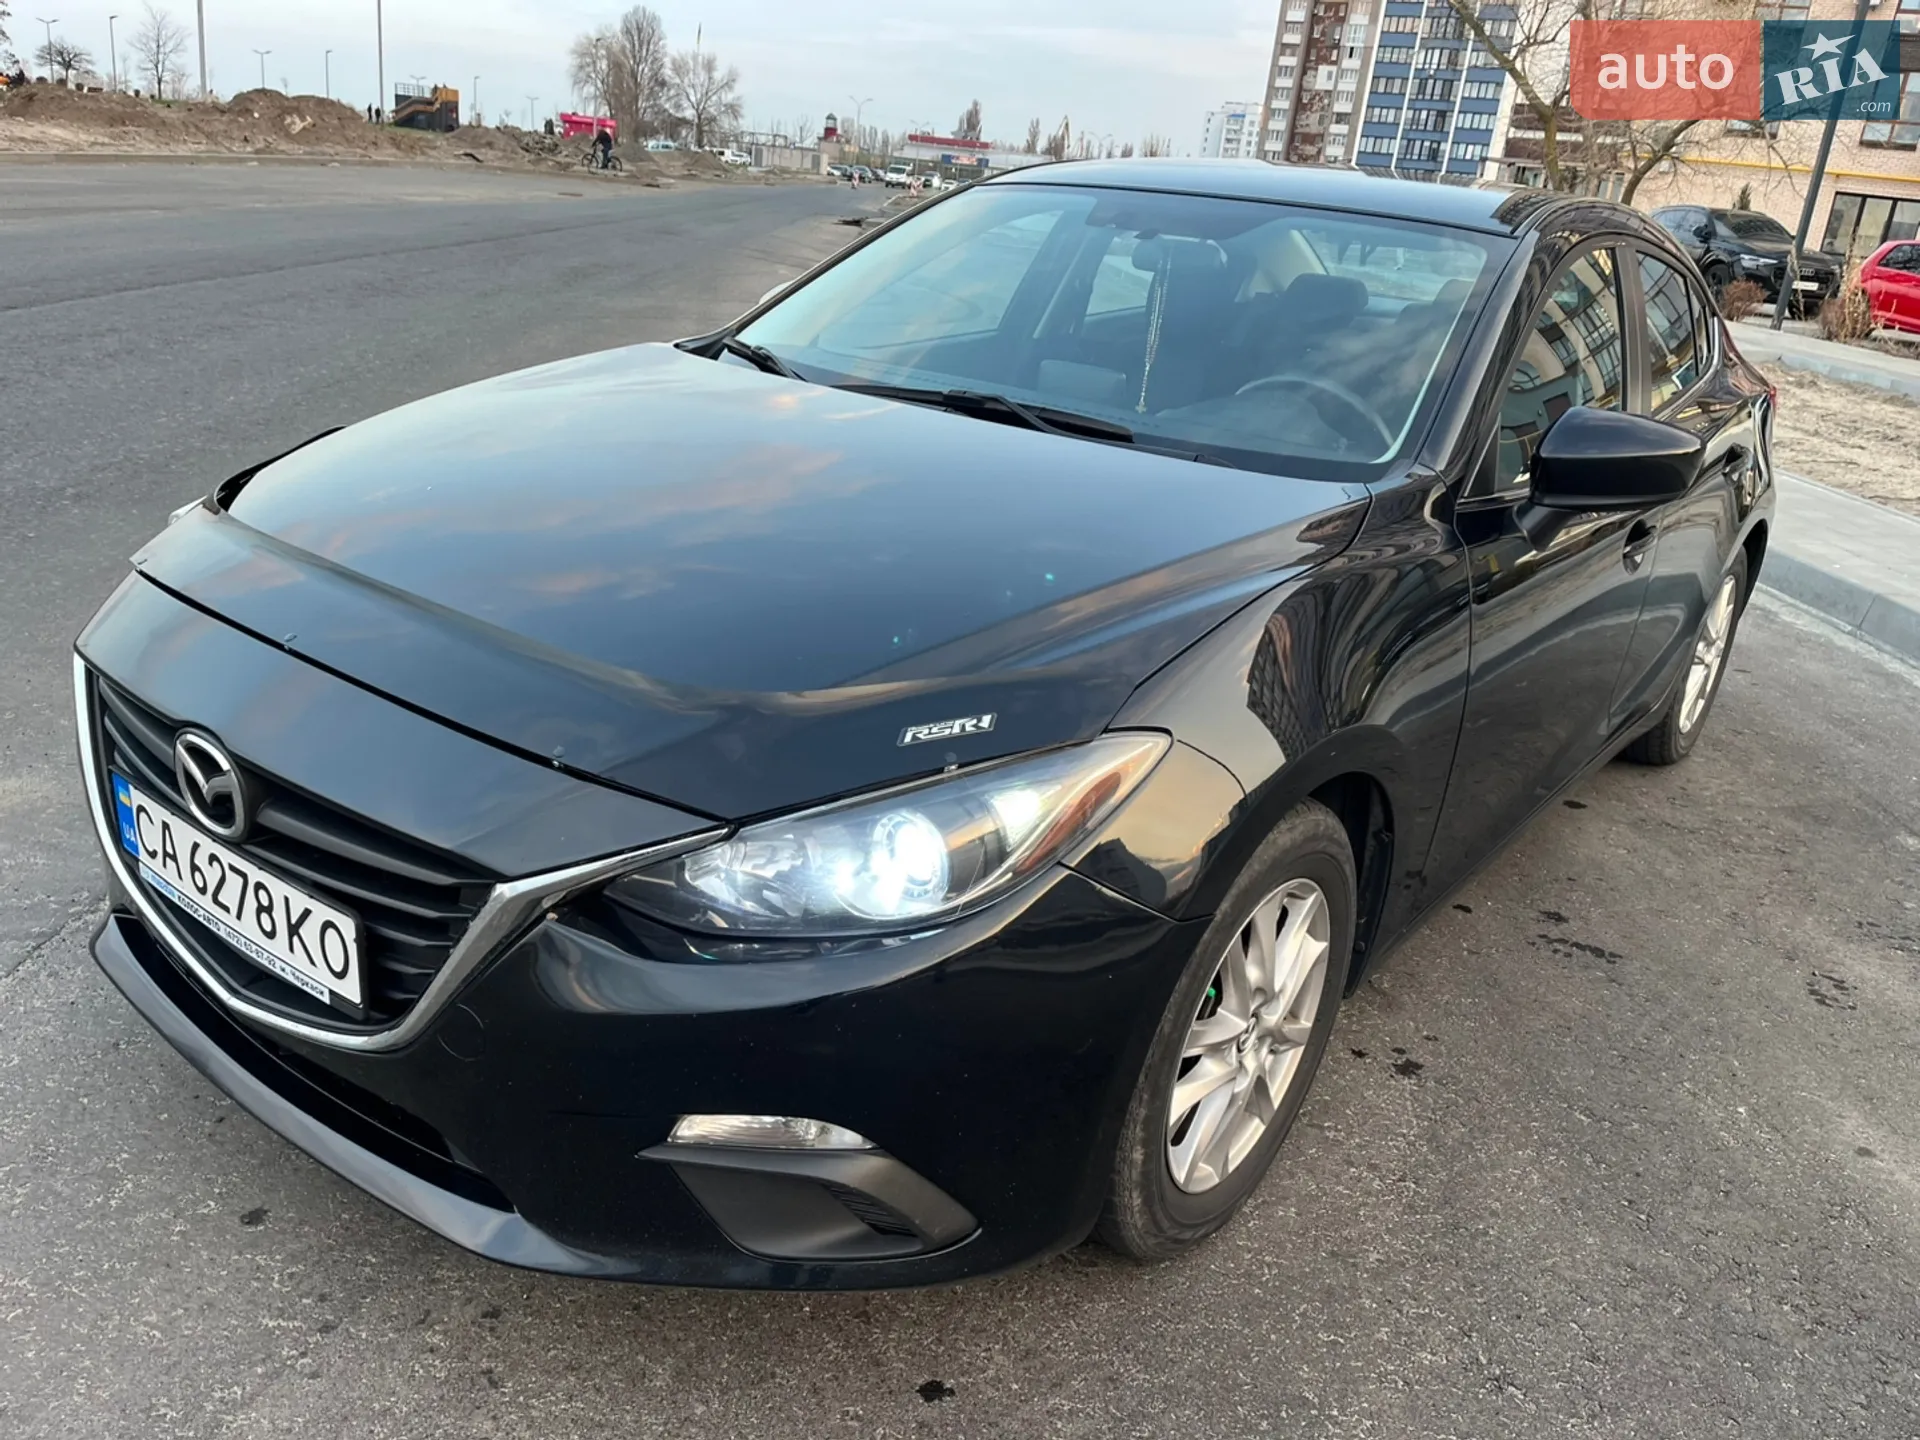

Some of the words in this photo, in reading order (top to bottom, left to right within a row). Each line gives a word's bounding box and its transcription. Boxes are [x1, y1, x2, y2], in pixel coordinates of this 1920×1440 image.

[123, 823, 137, 845] UA
[135, 804, 184, 884] CA
[189, 841, 278, 940] 6278
[283, 894, 351, 981] KO
